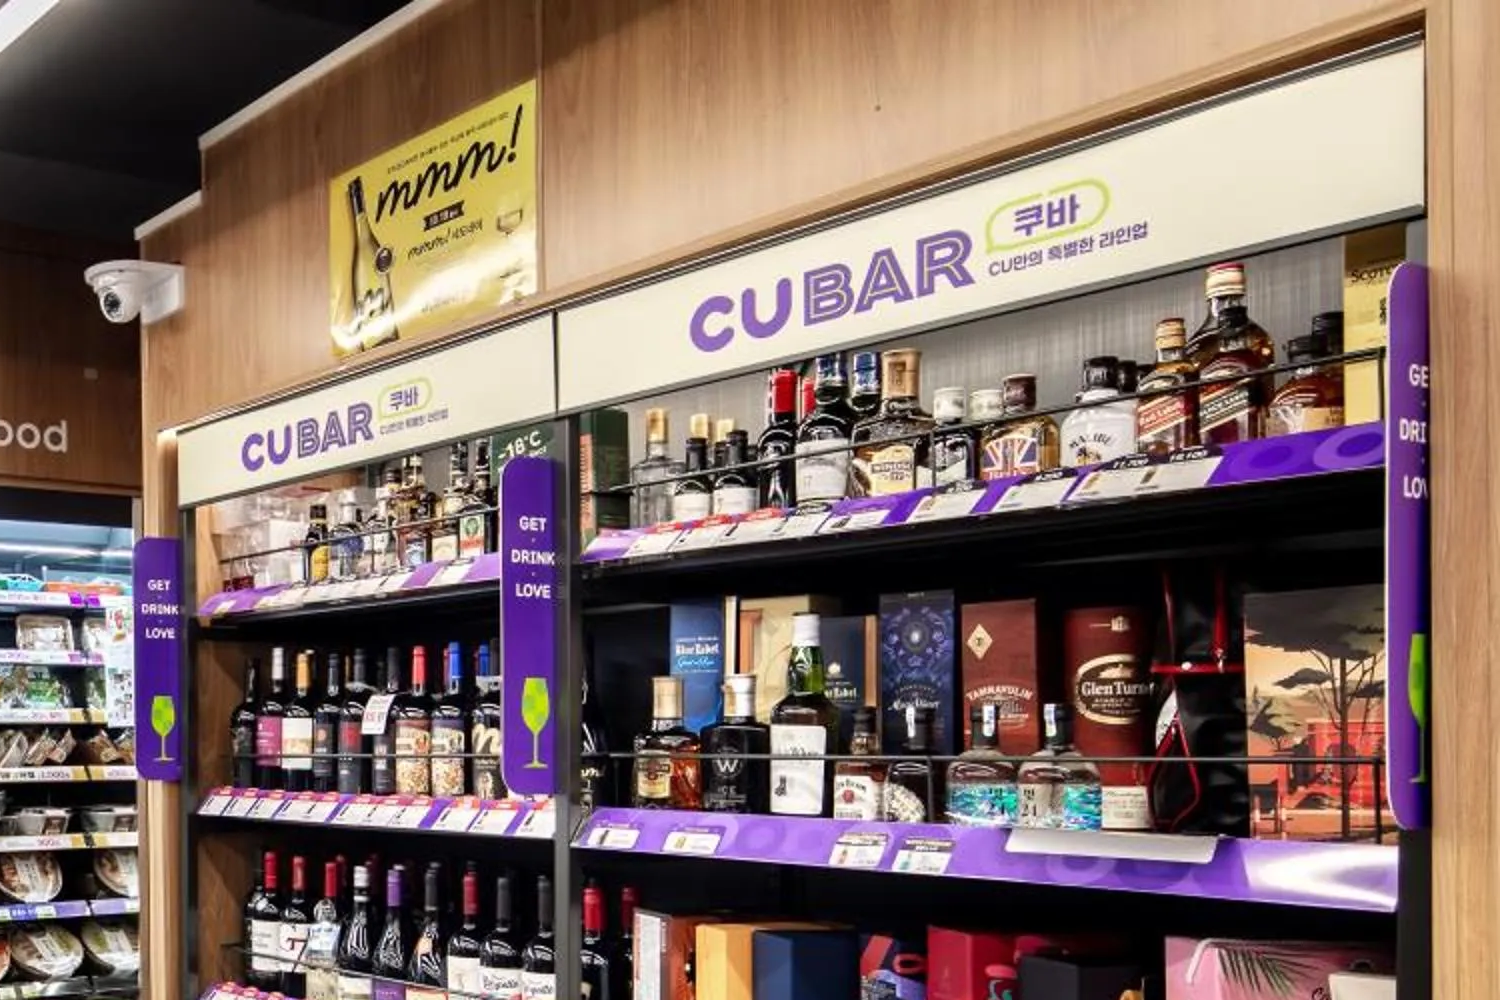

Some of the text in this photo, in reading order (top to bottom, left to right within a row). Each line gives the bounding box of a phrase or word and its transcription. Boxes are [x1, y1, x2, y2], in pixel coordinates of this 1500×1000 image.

[1012, 193, 1081, 238] 쿠바
[988, 221, 1150, 277] CU만의 특별한 라인업
[1409, 365, 1429, 387] GE
[389, 386, 420, 411] 쿠바
[1400, 417, 1427, 441] DRI
[1403, 476, 1428, 499] LOV
[519, 516, 547, 531] GET
[511, 549, 556, 566] DRINK
[147, 580, 171, 592] GET
[515, 583, 551, 599] LOVE
[141, 603, 179, 616] DRINK
[145, 627, 176, 639] LOVE
[1116, 681, 1155, 696] Turn
[715, 760, 739, 774] W
